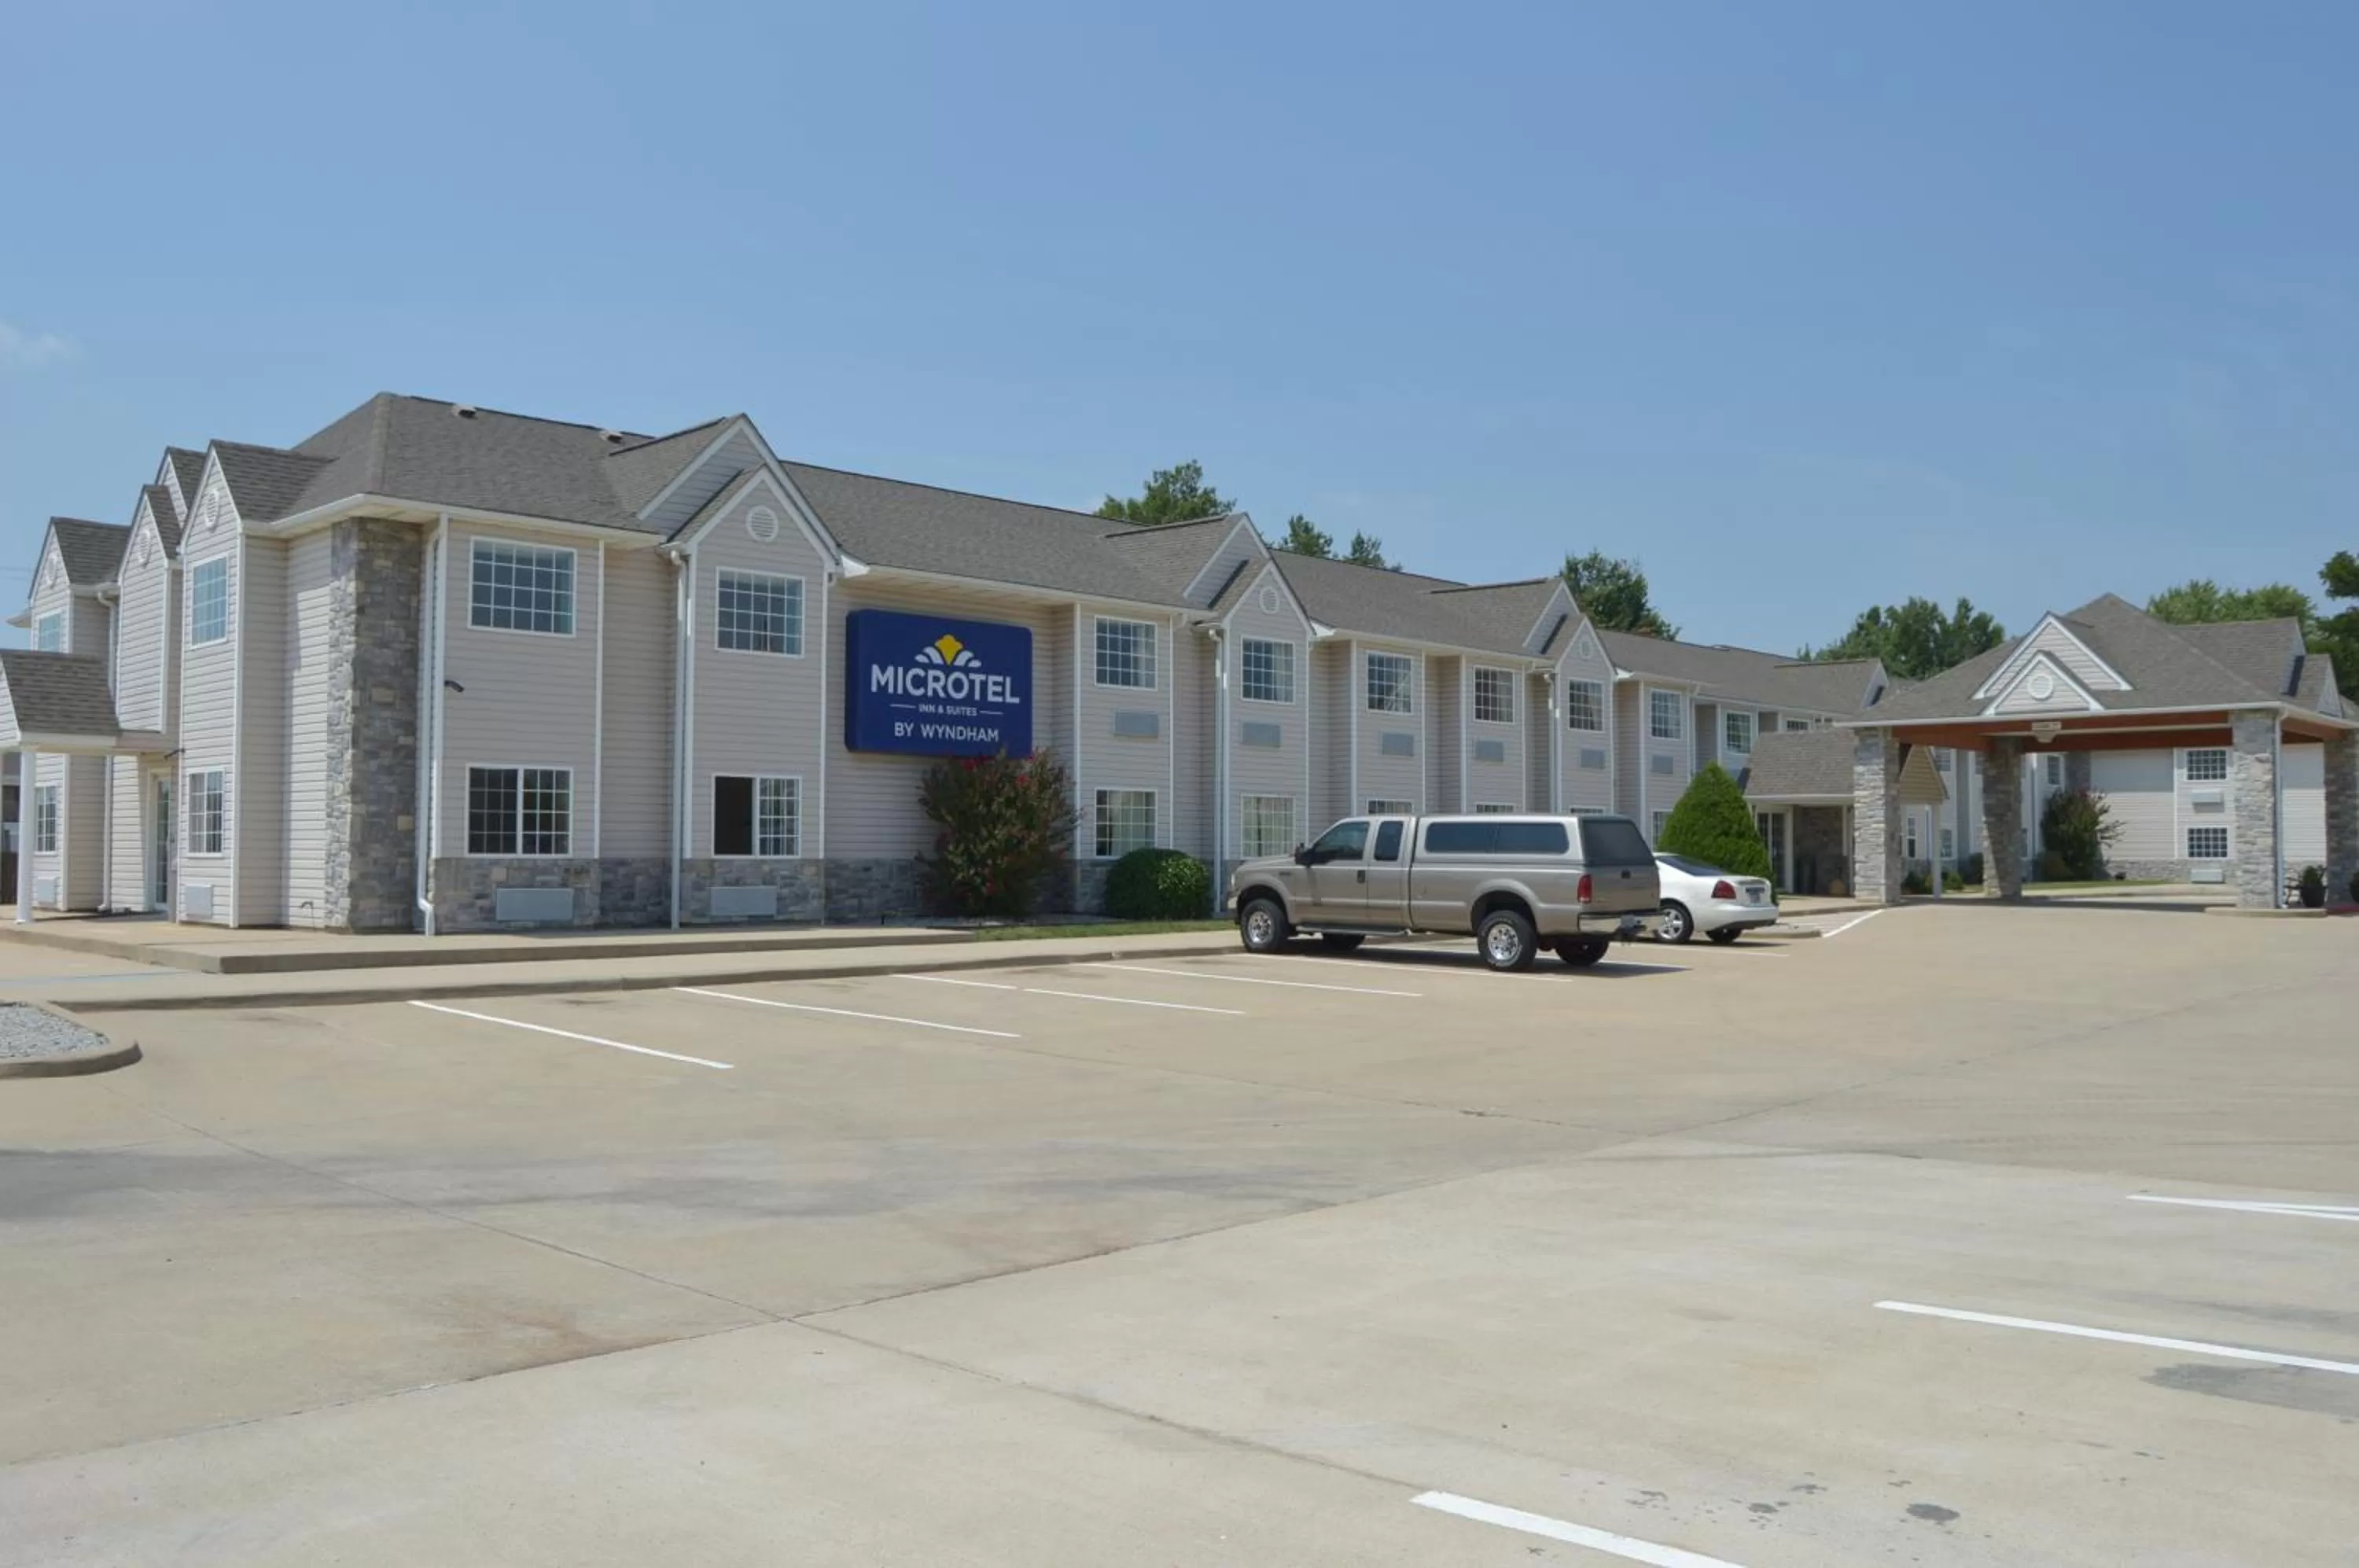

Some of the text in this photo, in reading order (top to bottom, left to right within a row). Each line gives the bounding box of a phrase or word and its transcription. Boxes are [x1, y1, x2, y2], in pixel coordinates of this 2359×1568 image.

[870, 664, 1020, 704] MICROTEL
[918, 704, 977, 716] INN & SUITES
[894, 722, 999, 742] BY WYNDHAM
